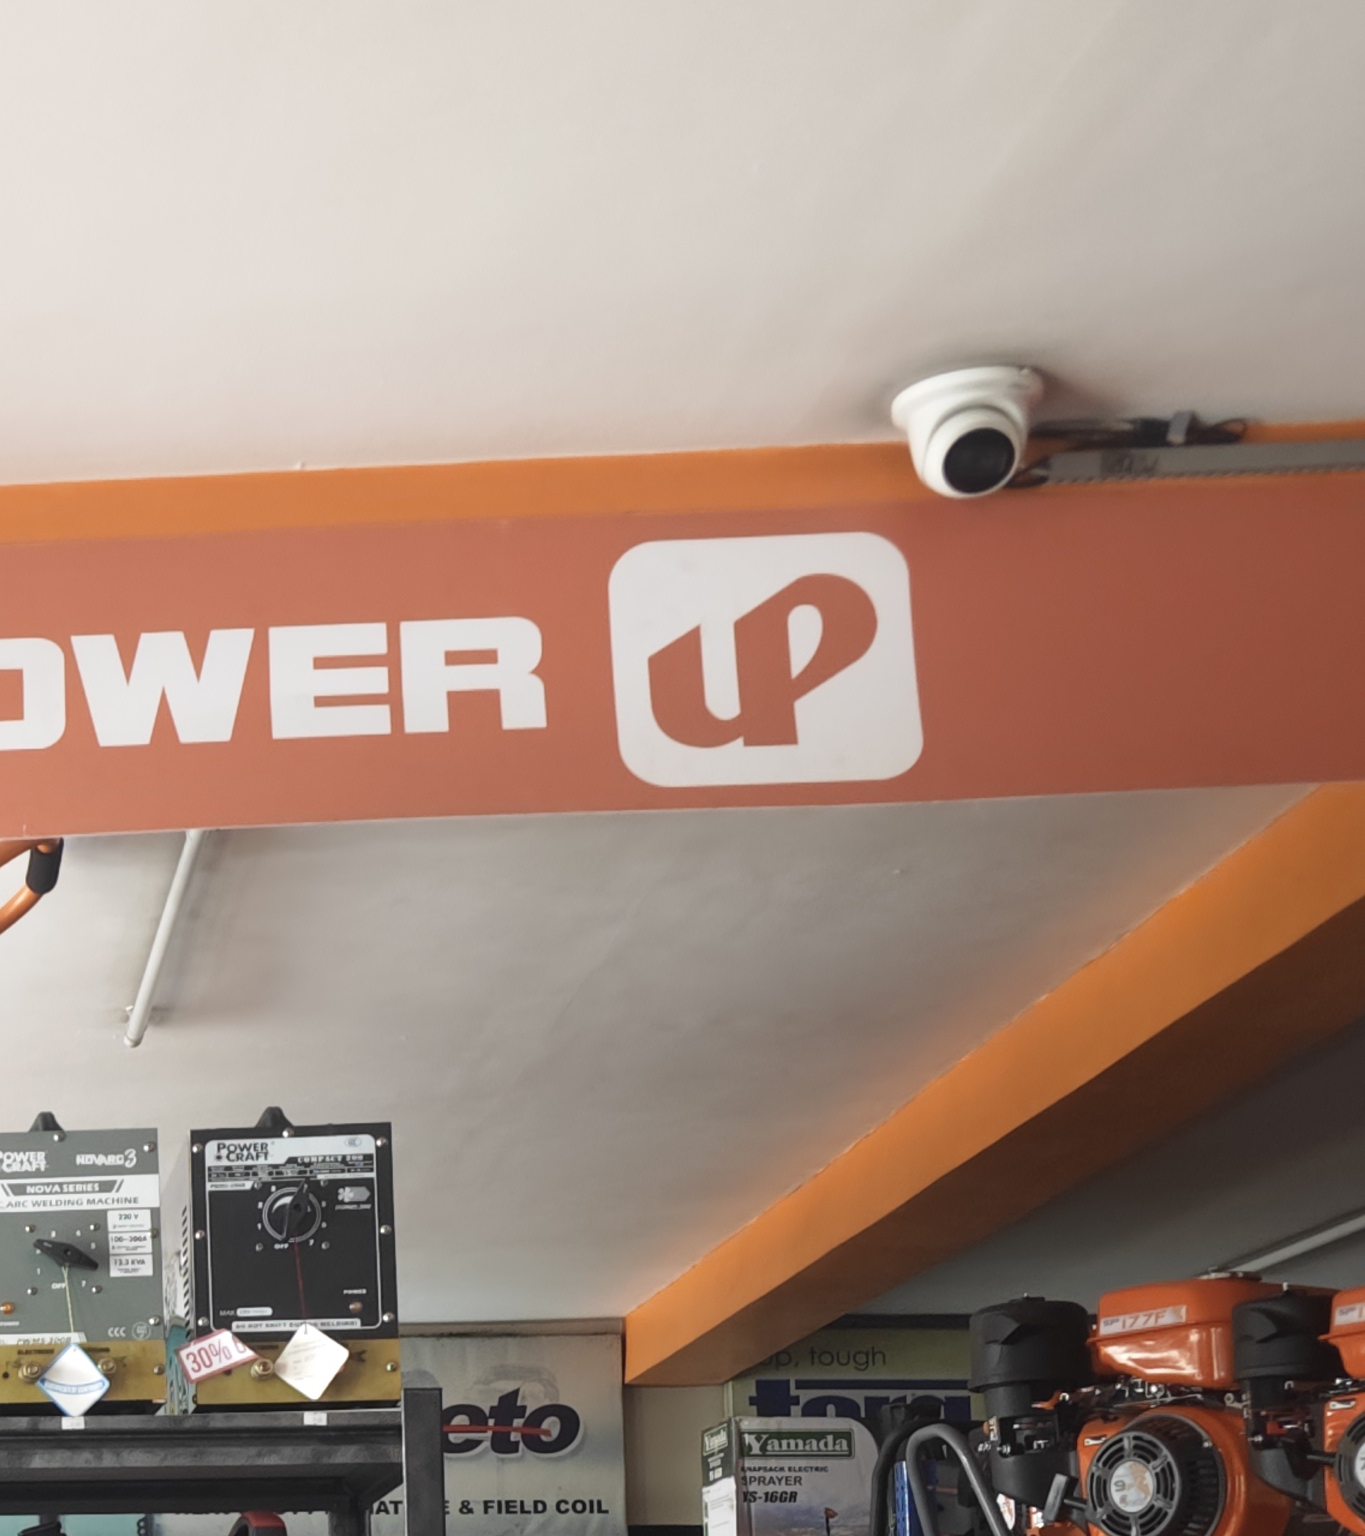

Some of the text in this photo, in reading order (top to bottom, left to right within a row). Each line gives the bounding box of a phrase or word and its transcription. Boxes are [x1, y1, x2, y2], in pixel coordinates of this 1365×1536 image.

[217, 1142, 268, 1153] POWER
[226, 1151, 269, 1162] CRAFT
[3, 1161, 47, 1172] CRAFT
[63, 1183, 99, 1192] SERIES
[32, 1198, 83, 1207] WELDING
[87, 1197, 139, 1205] MACHINE
[1122, 1311, 1166, 1329] 177F
[186, 1340, 232, 1374] 30%
[810, 1347, 886, 1371] tough
[745, 1433, 849, 1455] Yamada
[741, 1476, 803, 1486] SPRAYER
[459, 1499, 609, 1514] & FIELD COIL
